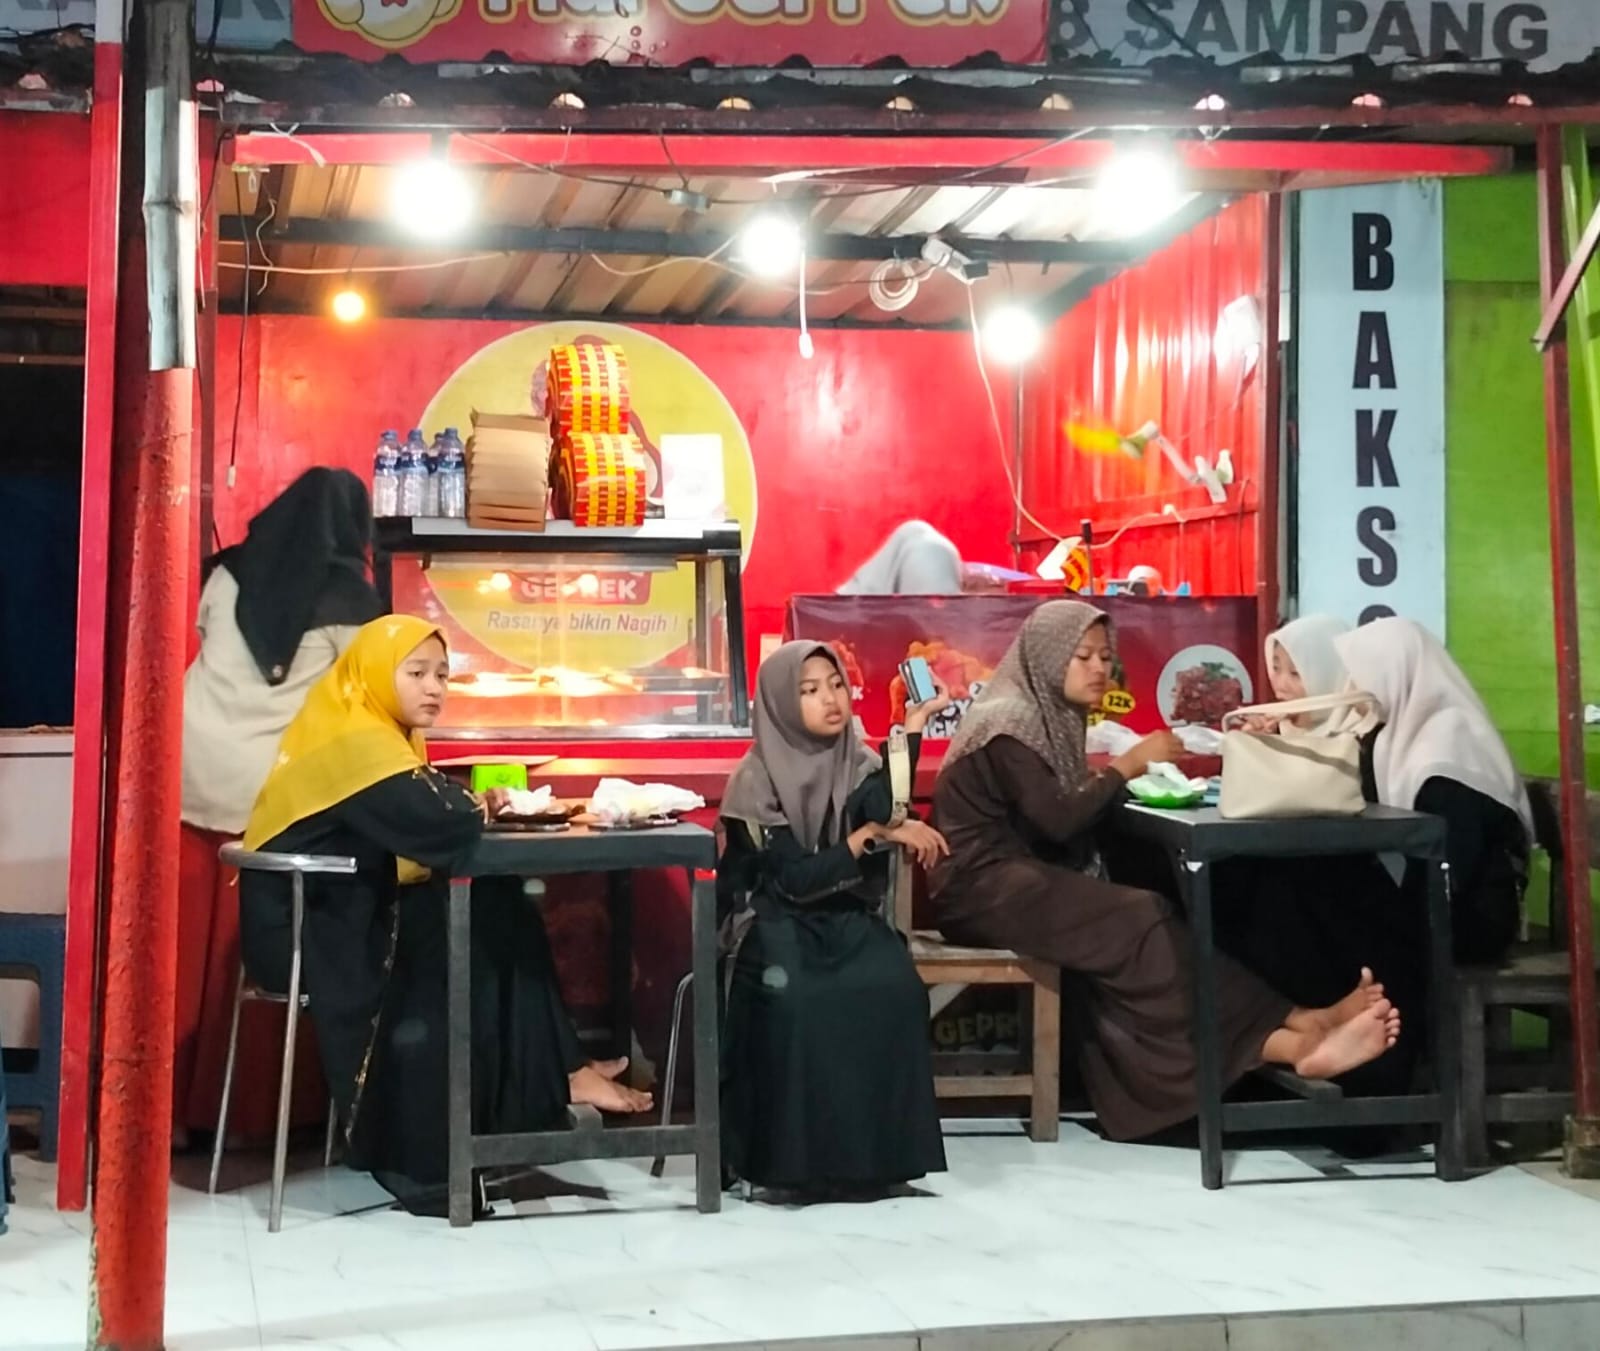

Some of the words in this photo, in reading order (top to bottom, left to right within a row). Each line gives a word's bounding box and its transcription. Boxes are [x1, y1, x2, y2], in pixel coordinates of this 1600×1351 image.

[1124, 0, 1548, 60] SAMPANG
[1352, 212, 1400, 627] BAKS
[519, 576, 637, 600] GEEK
[569, 613, 611, 631] bikin
[616, 614, 667, 635] Nagih
[1107, 693, 1133, 709] 12K
[934, 1011, 1017, 1045] GEPR
